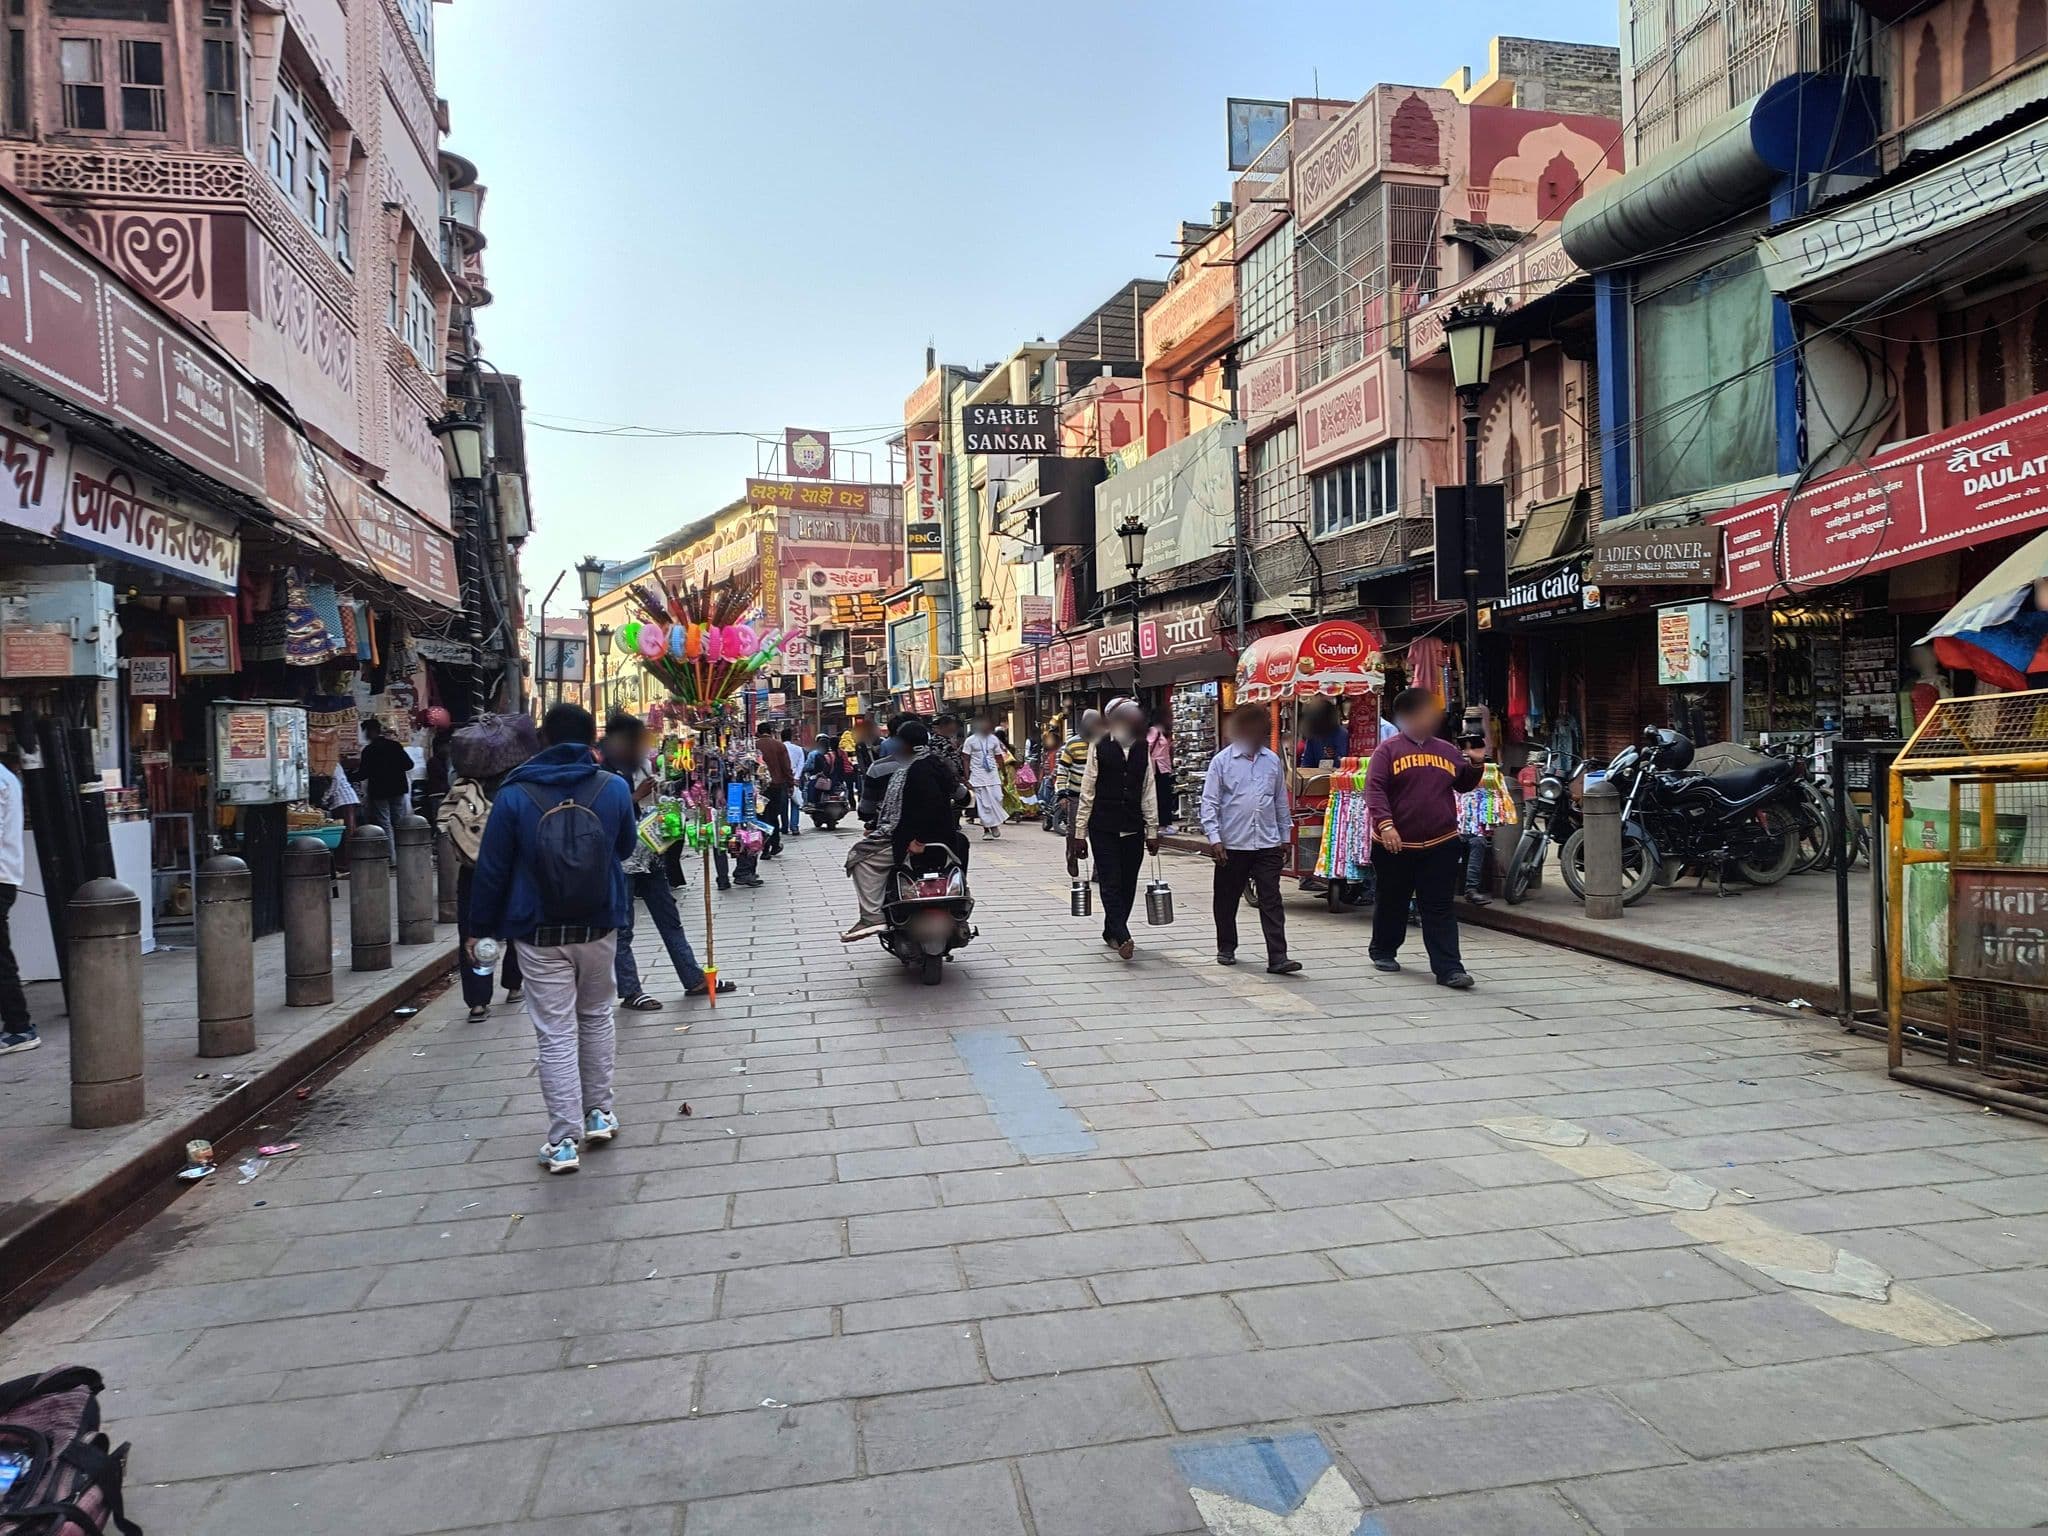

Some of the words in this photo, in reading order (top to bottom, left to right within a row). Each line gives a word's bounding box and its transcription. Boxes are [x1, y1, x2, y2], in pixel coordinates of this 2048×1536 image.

[974, 408, 1039, 426] SAREE
[968, 434, 1048, 451] SANSAR
[1963, 455, 2048, 496] DAULAT
[1598, 545, 1642, 562] LADIES
[1644, 542, 1703, 560] CORNER
[1665, 561, 1701, 570] COSMETICS
[1163, 606, 1206, 643] गौरी
[1099, 630, 1132, 657] GAURI
[1393, 753, 1457, 778] CATERPILLAR
